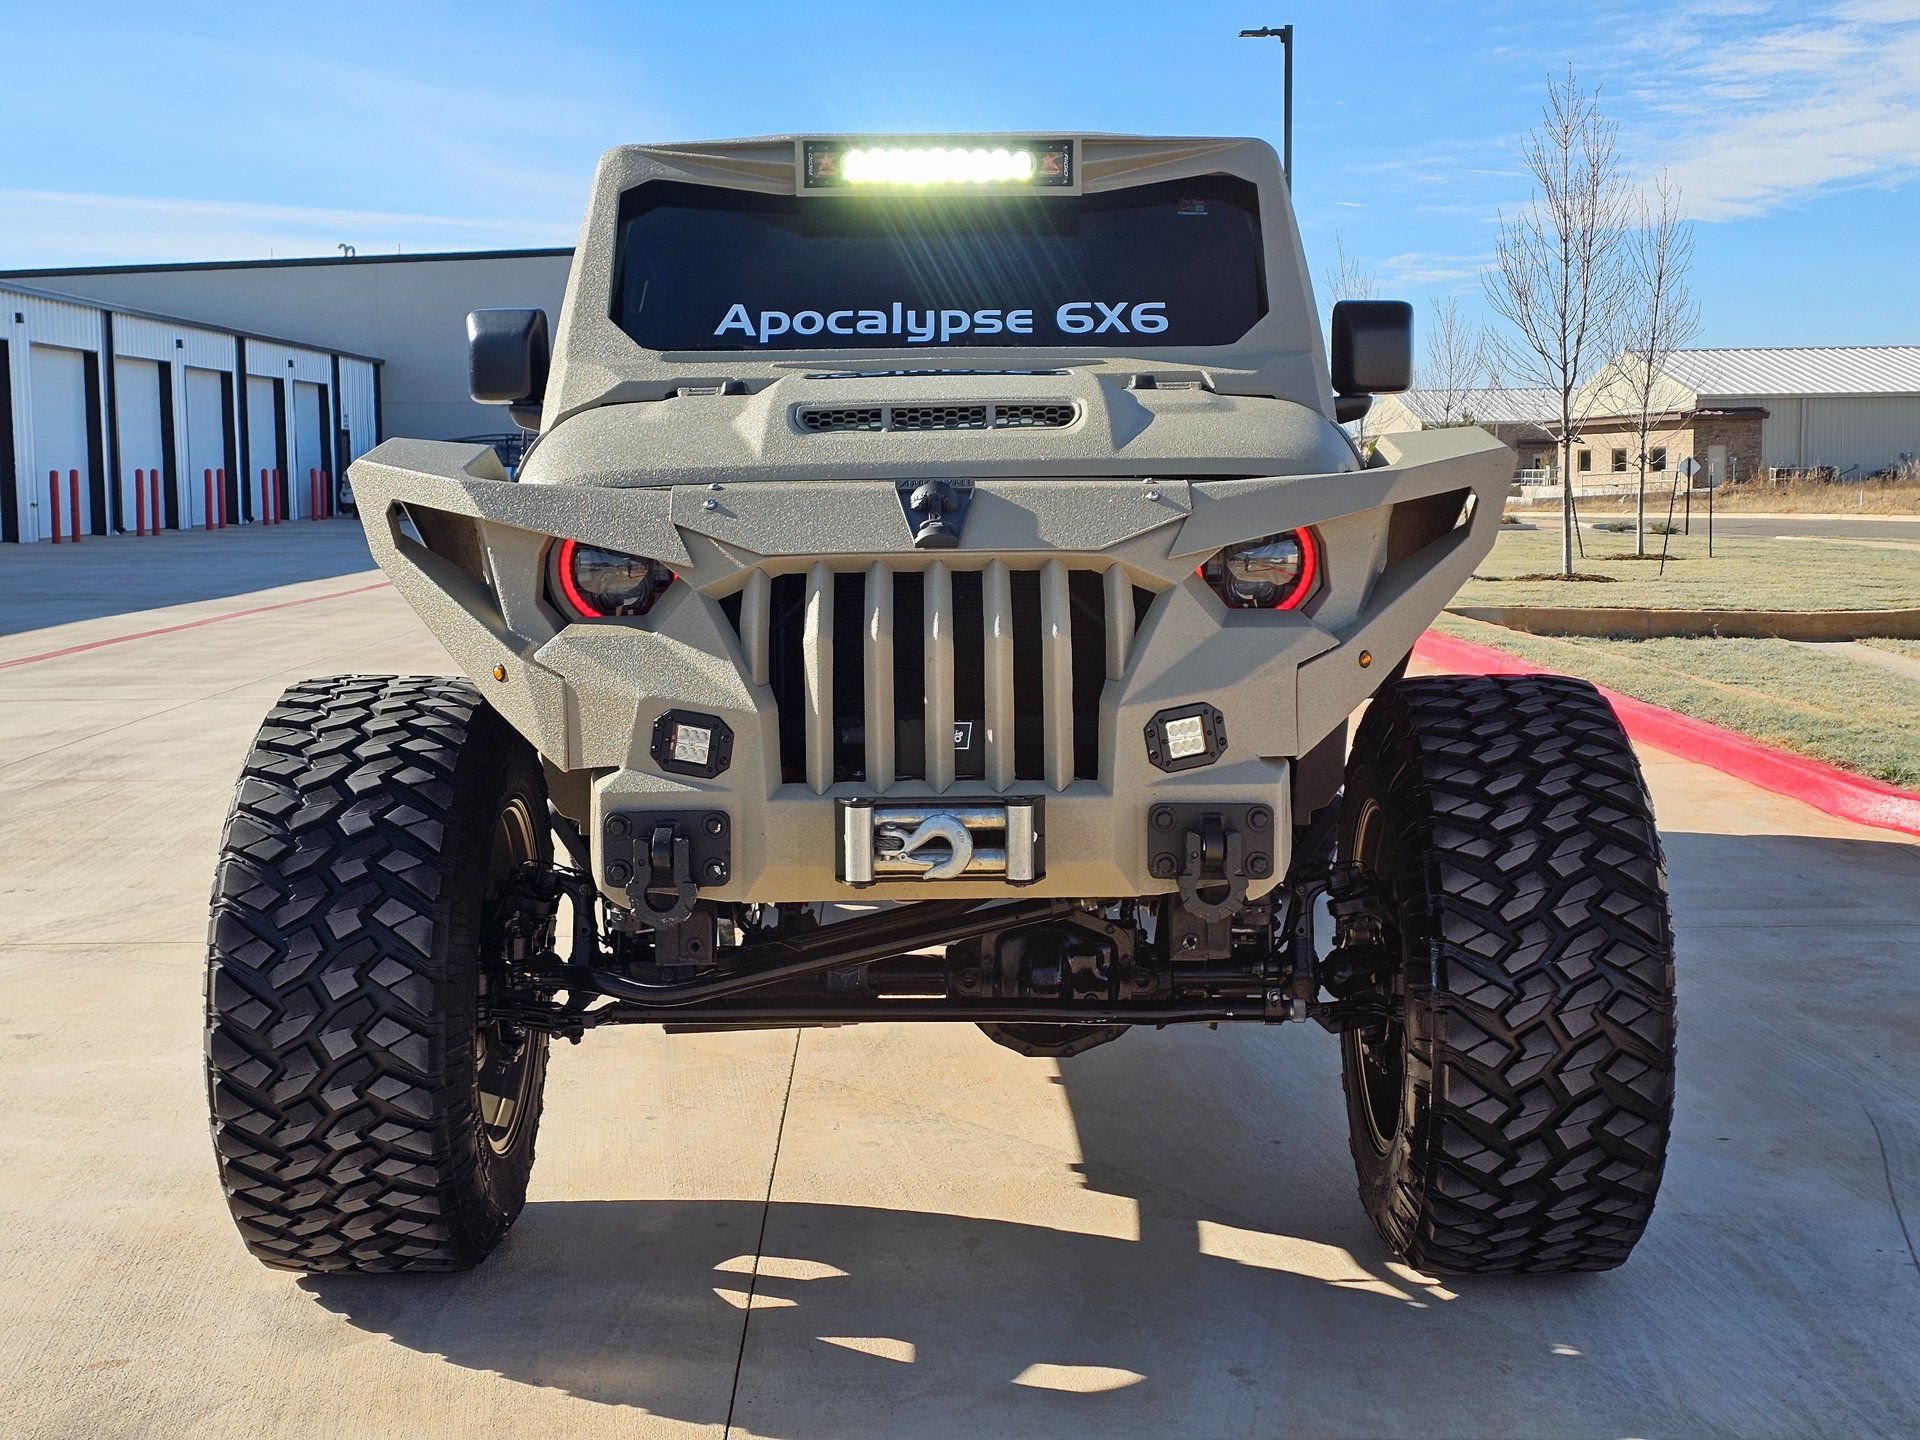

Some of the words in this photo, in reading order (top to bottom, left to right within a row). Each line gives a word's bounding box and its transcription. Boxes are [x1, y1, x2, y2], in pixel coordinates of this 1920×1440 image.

[713, 302, 1033, 343] Apocalypse
[1056, 302, 1169, 334] 6X6
[899, 479, 973, 488] APOYPSE
